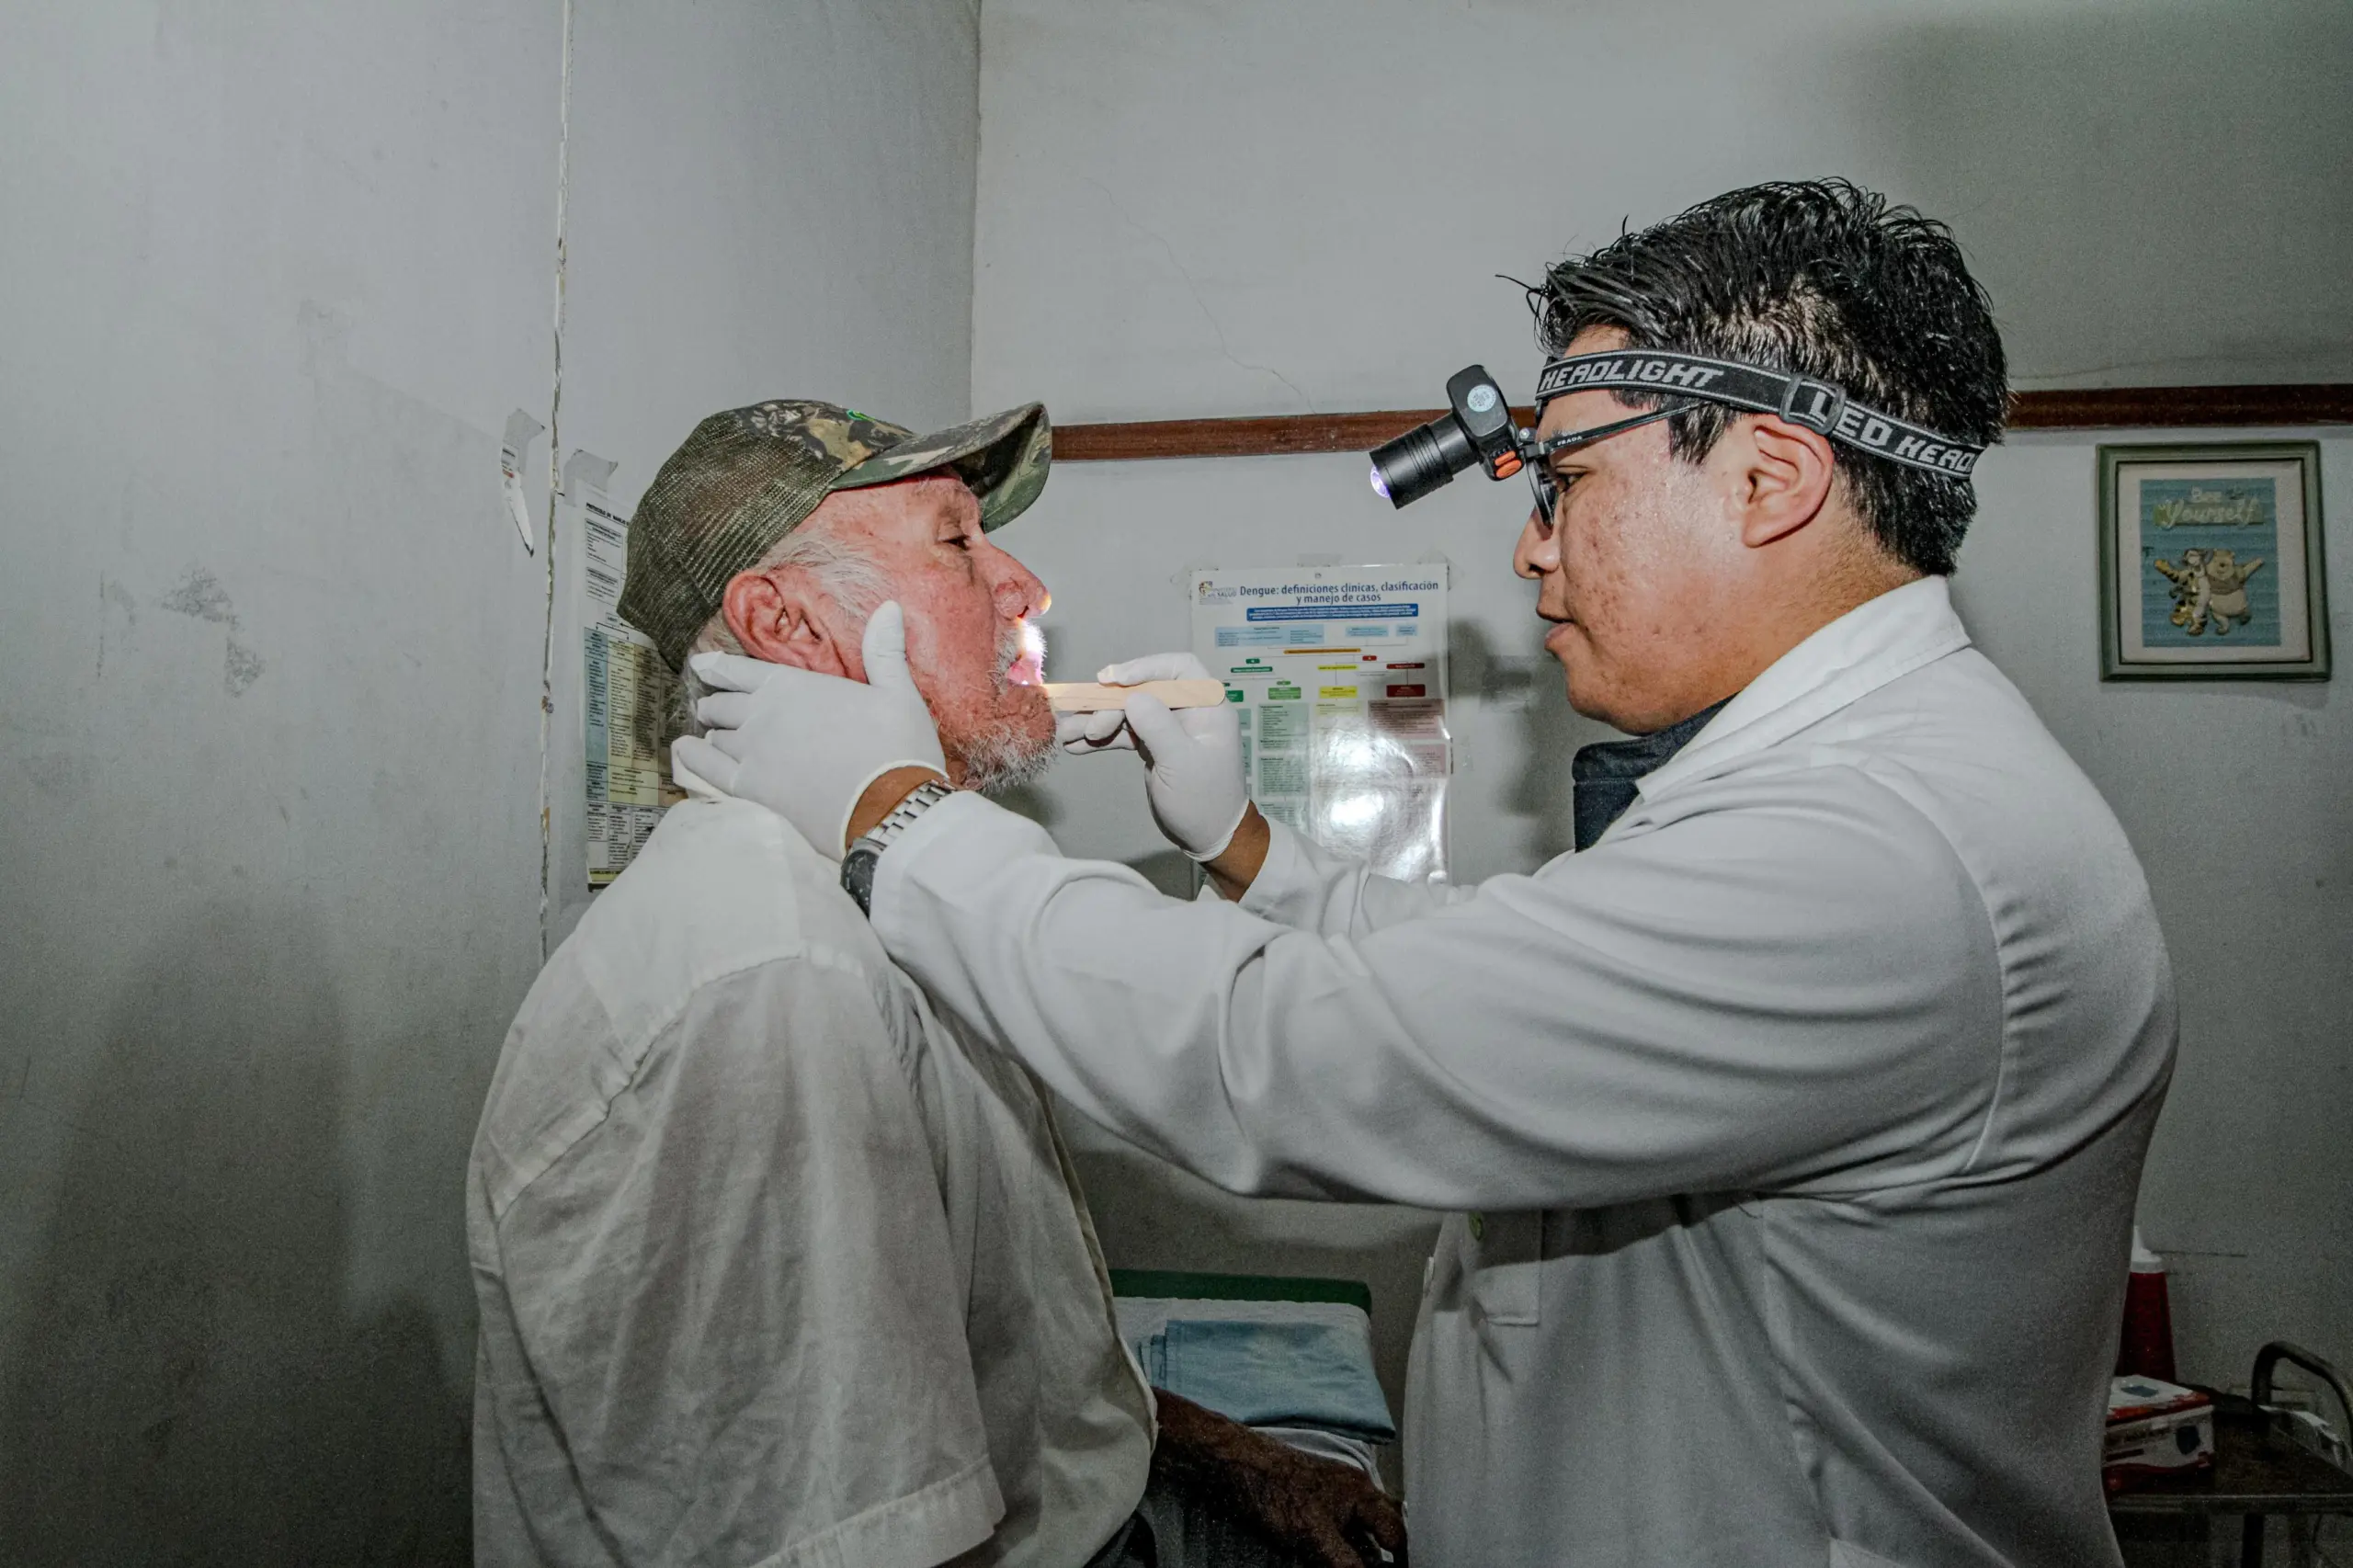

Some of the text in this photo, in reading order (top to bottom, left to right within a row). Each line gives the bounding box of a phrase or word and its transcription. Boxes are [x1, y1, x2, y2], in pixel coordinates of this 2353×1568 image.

[1540, 359, 1723, 392] HEADLIGHT
[1809, 392, 1976, 472] LED HEAD
[1556, 436, 1583, 447] PRADA
[1240, 585, 1279, 597] Dengue:
[1281, 583, 1339, 596] definiciones
[1381, 581, 1438, 593] clasificación
[1296, 593, 1381, 605] y manejo de casos
